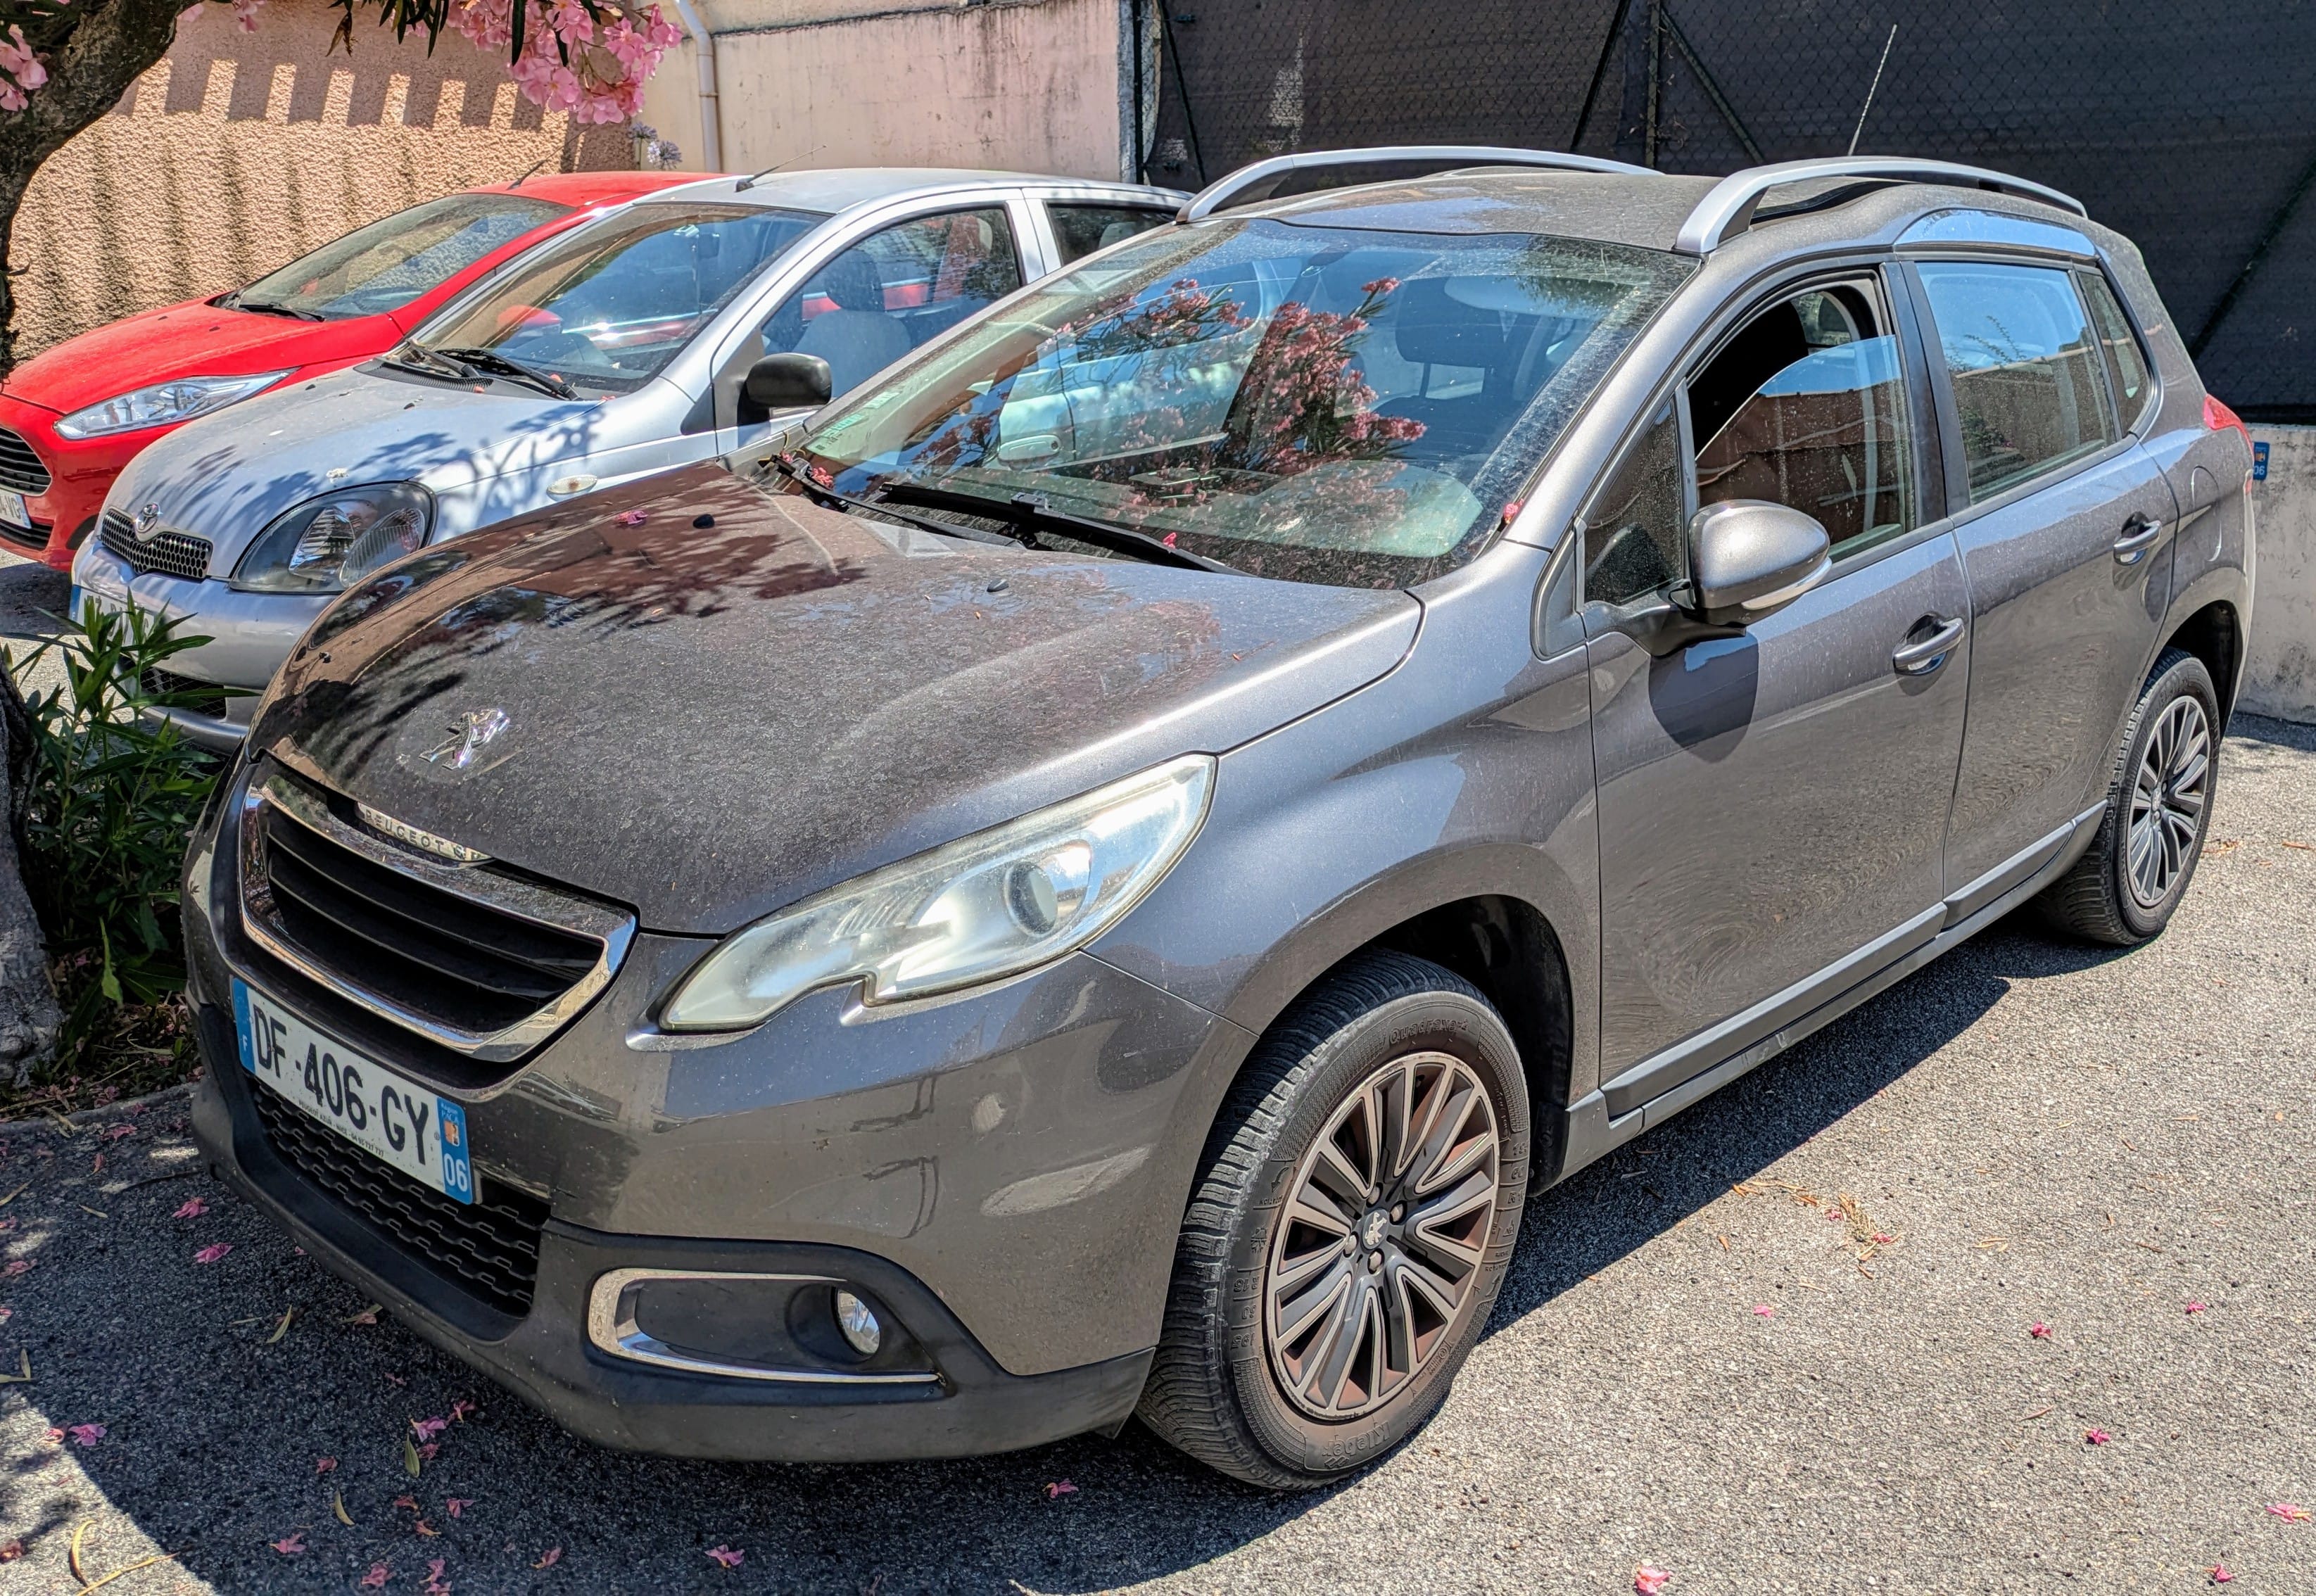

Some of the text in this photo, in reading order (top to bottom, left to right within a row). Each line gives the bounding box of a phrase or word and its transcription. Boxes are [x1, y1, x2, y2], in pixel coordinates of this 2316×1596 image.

[365, 809, 444, 855] PEUGEOT
[242, 1034, 248, 1051] F
[444, 1153, 468, 1192] 06
[1322, 1420, 1391, 1457] Kleber
